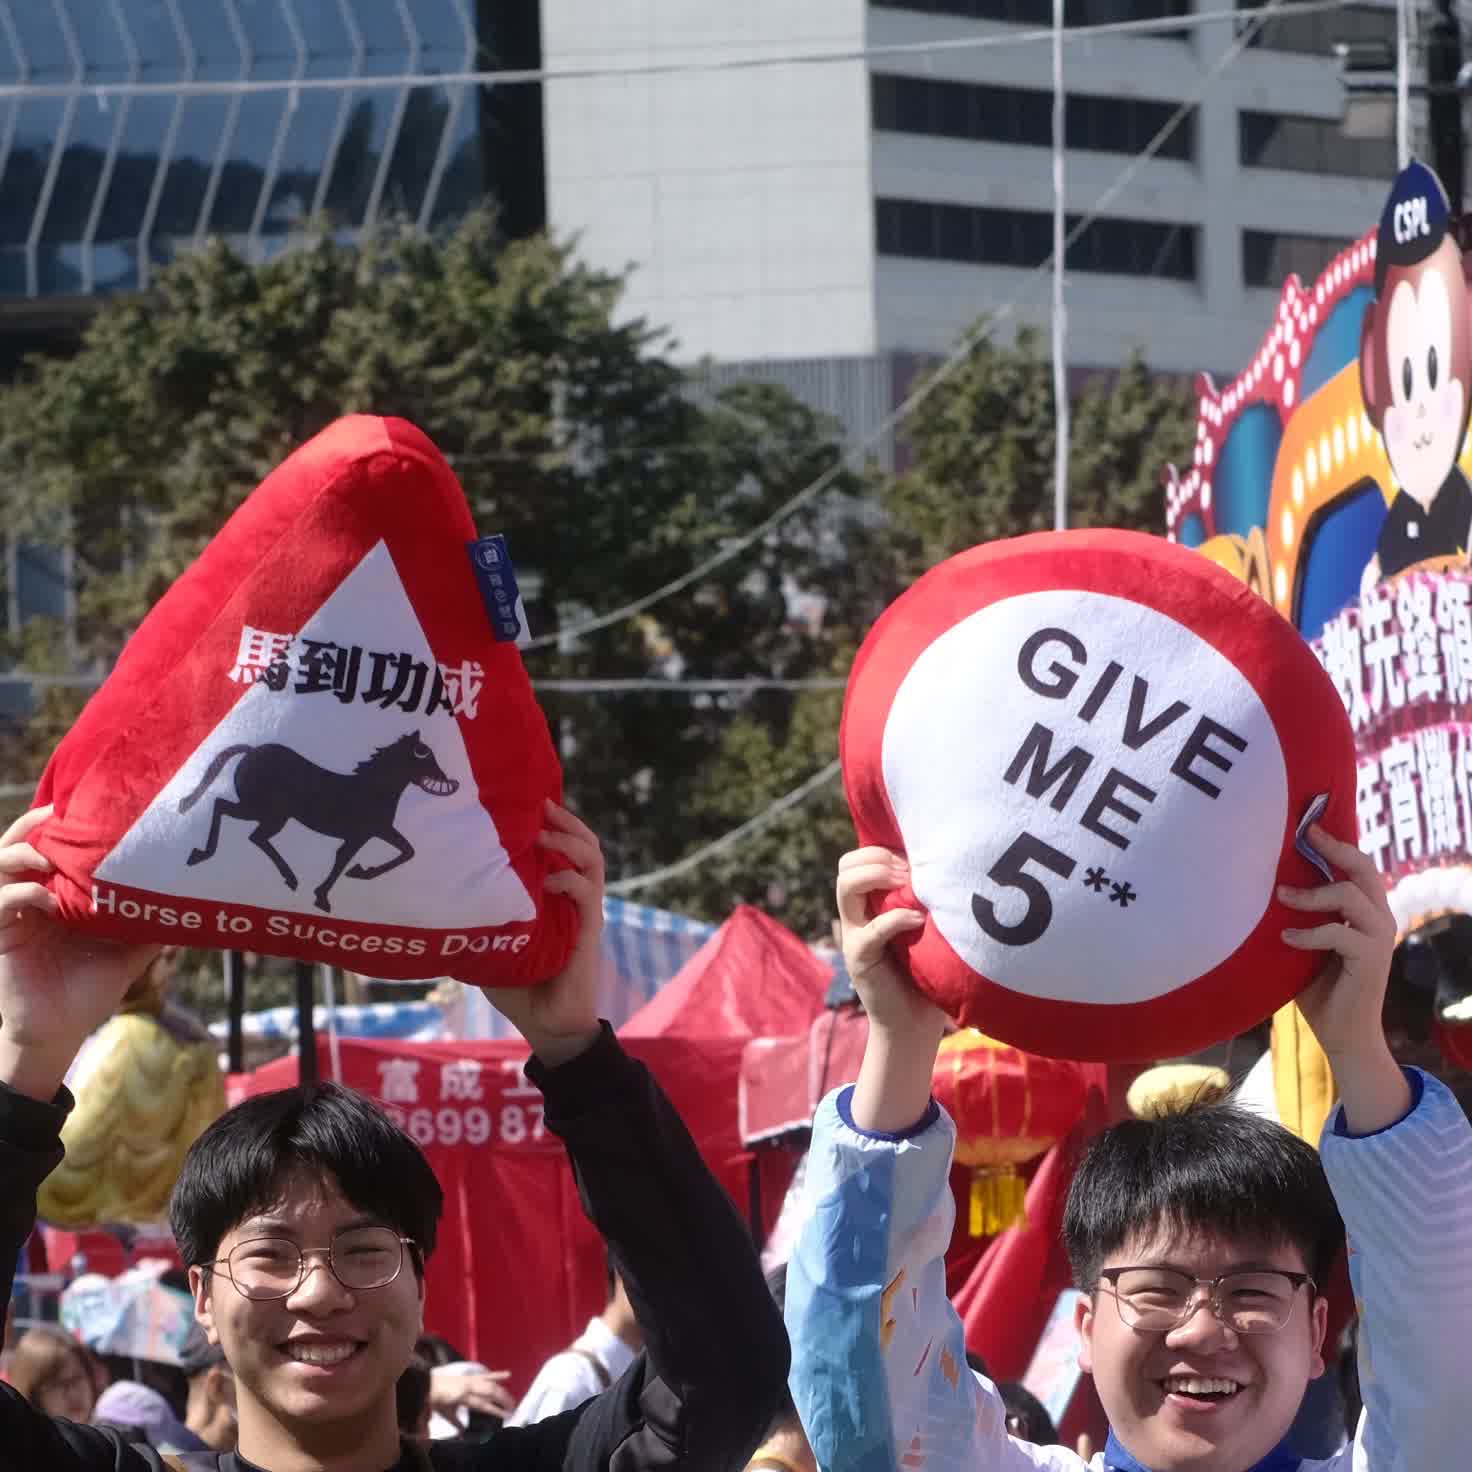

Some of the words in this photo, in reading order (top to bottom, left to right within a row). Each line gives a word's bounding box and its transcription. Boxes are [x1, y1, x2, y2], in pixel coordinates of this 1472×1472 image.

[1393, 196, 1431, 245] CSPL
[229, 624, 486, 721] 馬到功成
[1016, 627, 1248, 799] GIVE
[1003, 722, 1158, 850] ME
[91, 885, 202, 930] Horse
[215, 910, 254, 934] to
[265, 914, 428, 956] Success
